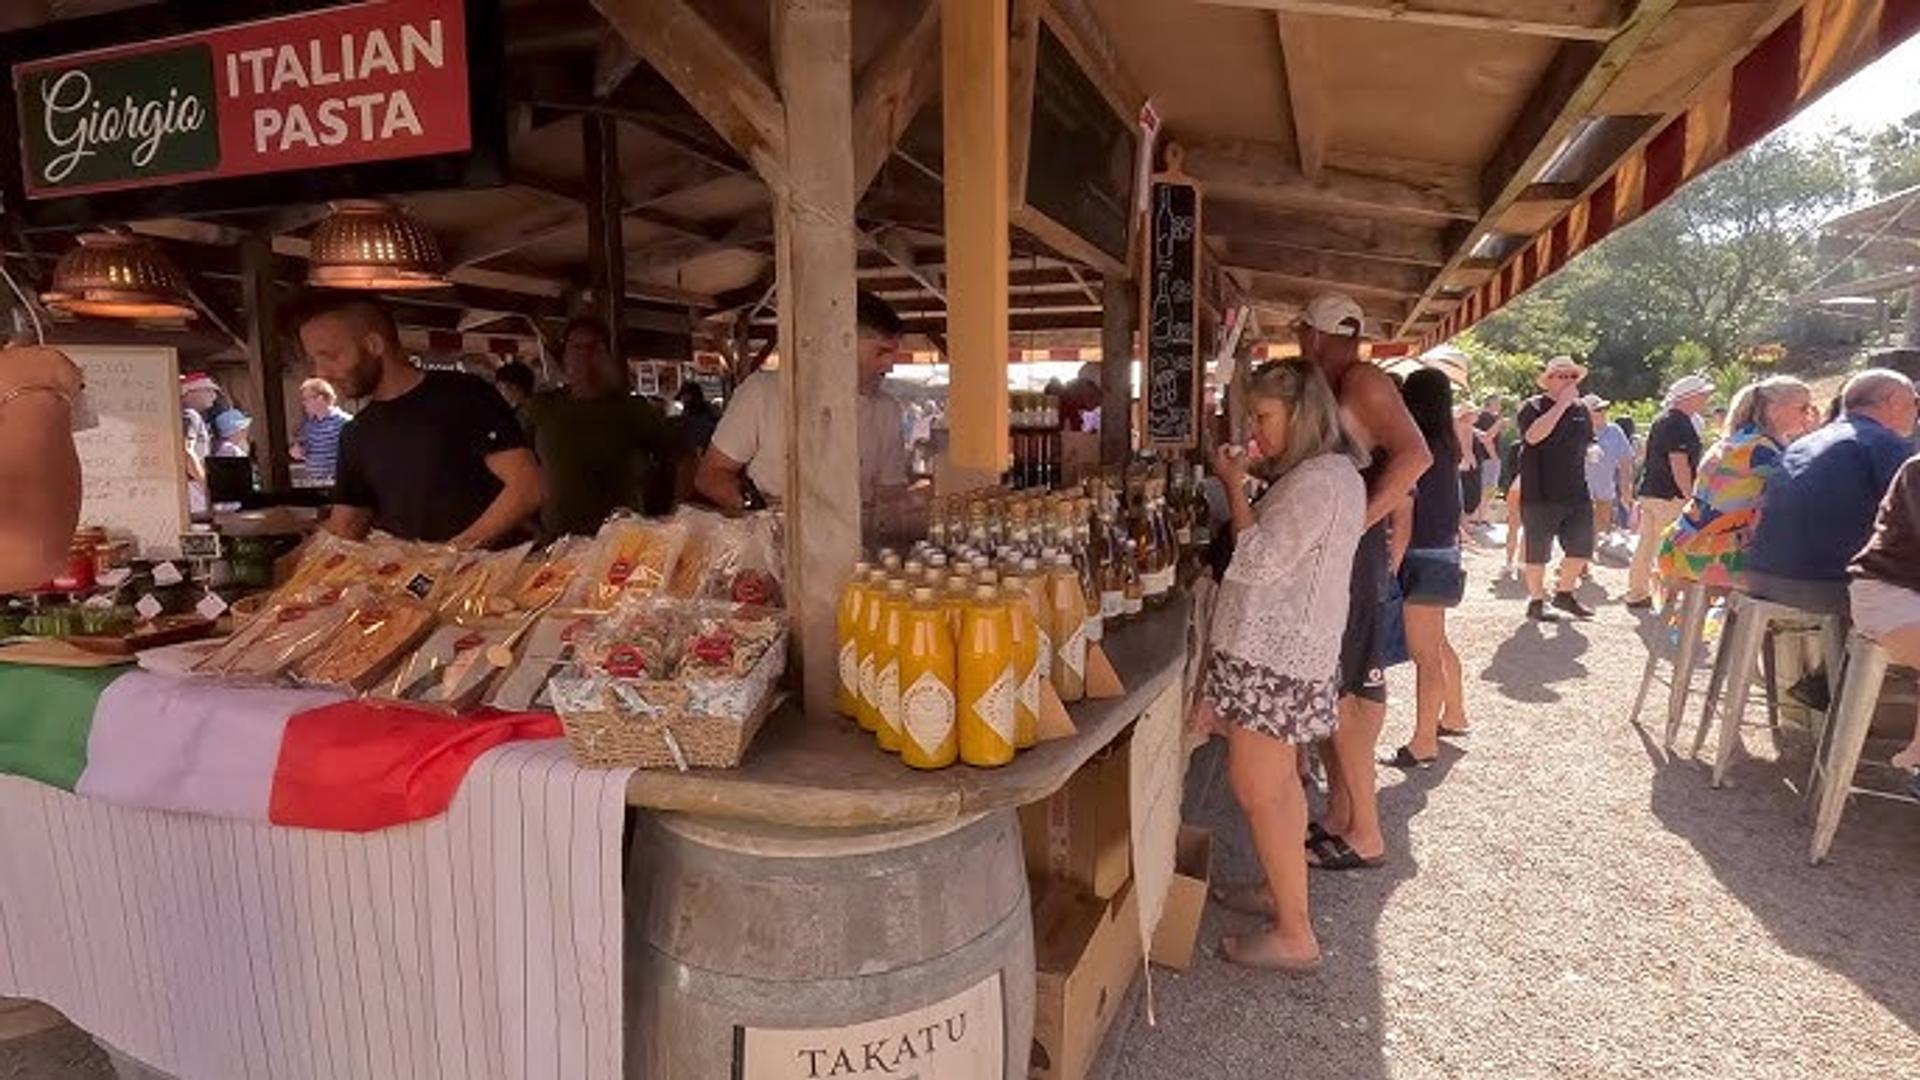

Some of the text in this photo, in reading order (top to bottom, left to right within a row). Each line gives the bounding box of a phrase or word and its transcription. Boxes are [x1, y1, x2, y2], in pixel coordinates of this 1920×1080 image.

[226, 20, 444, 98] ITALIAN
[41, 69, 205, 183] Giorgio
[254, 90, 423, 153] PASTA
[798, 1012, 966, 1078] TAKATU
